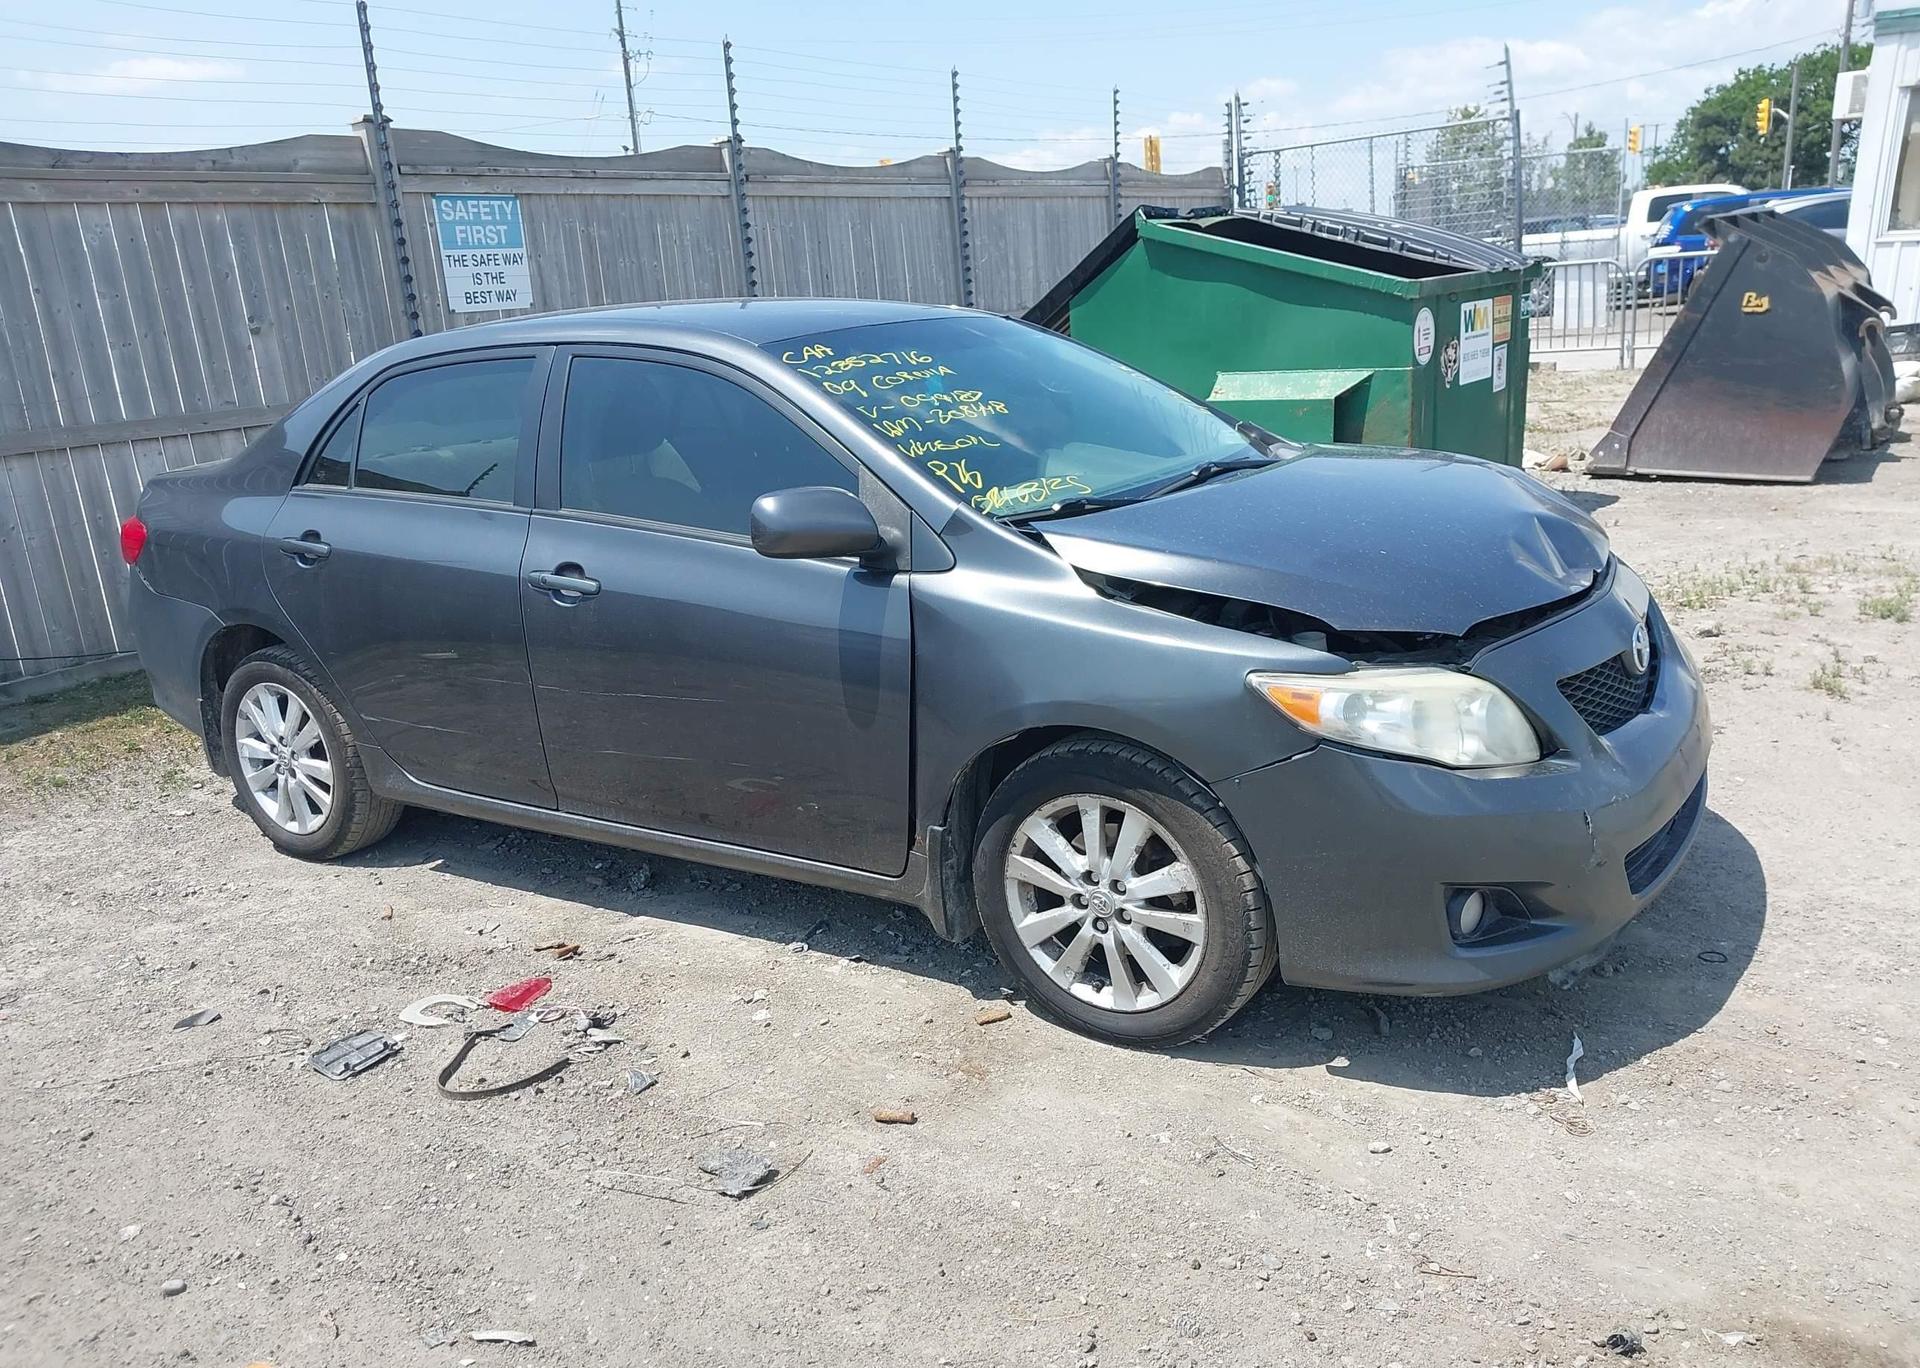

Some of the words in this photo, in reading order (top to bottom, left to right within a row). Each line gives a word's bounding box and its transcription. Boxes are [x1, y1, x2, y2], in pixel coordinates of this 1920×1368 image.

[441, 200, 513, 221] SAFETY
[455, 225, 507, 246] FIRST
[445, 254, 469, 268] THE
[471, 253, 500, 267] SAFE
[502, 252, 524, 266] WAY
[472, 272, 483, 286] IS
[483, 271, 506, 285] THE
[465, 291, 493, 304] BEST
[495, 289, 517, 303] WAY
[1464, 303, 1489, 333] WM
[782, 344, 834, 364] CAA
[823, 379, 869, 398] 09
